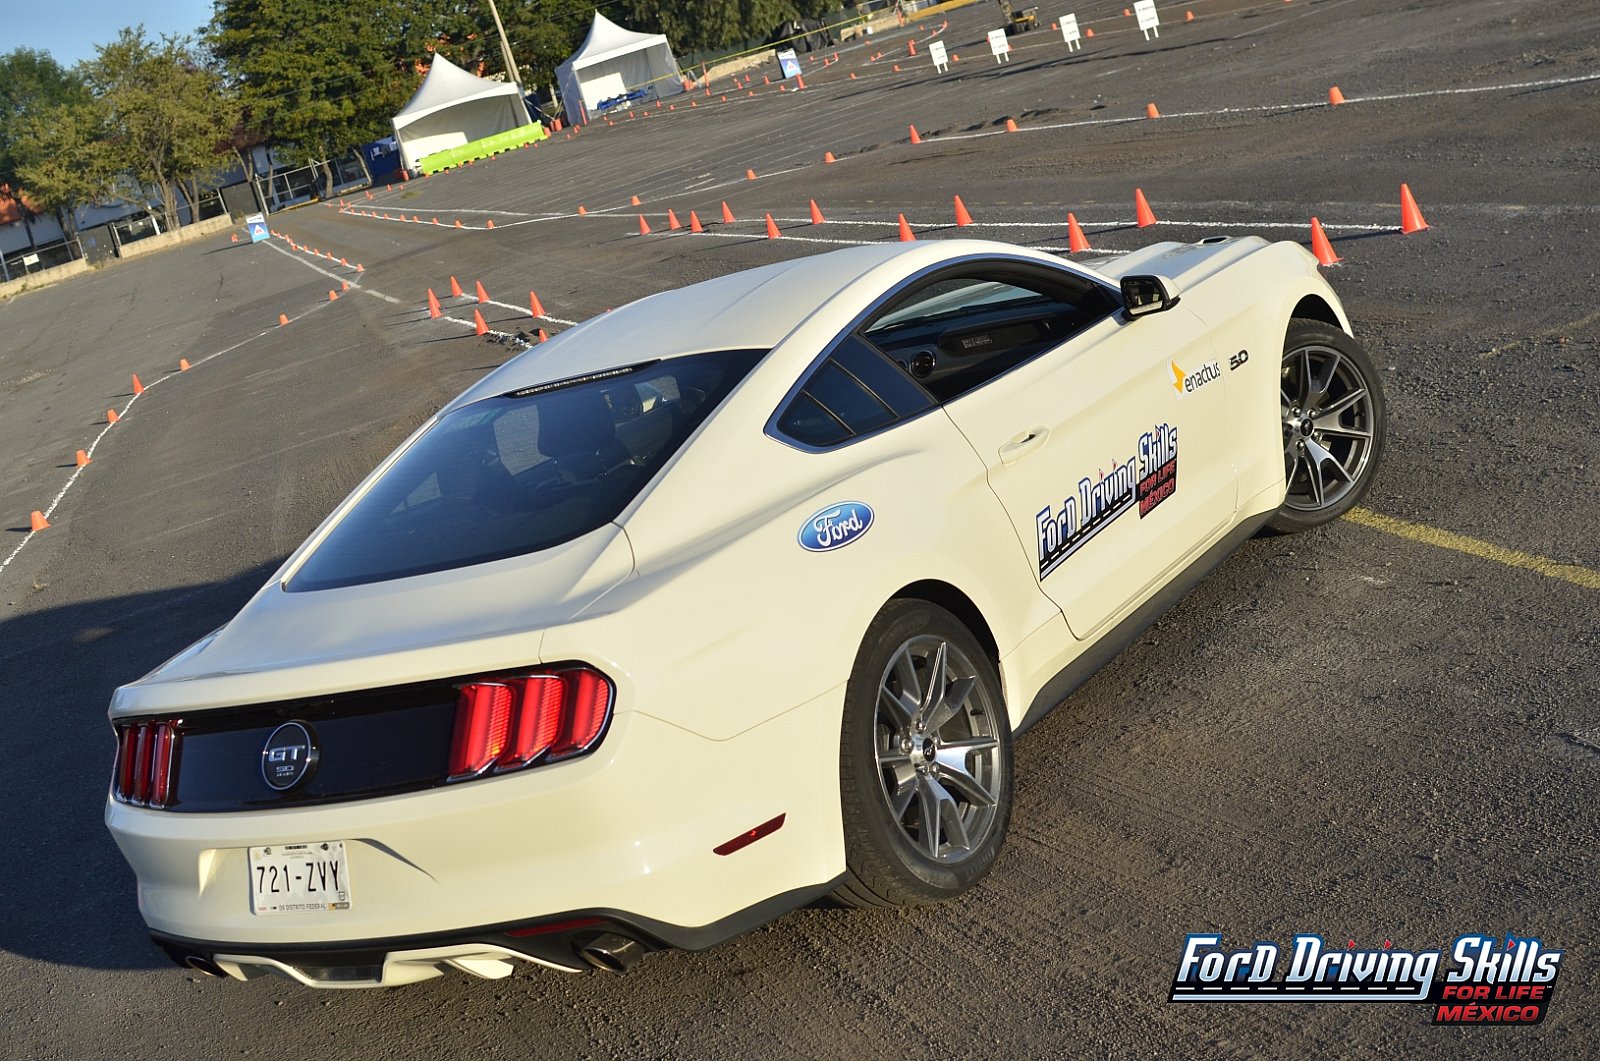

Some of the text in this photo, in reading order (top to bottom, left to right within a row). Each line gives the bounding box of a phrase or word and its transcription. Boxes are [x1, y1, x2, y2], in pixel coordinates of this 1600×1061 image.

[1184, 362, 1221, 393] enactus
[1078, 456, 1136, 528] Driving
[1138, 423, 1178, 480] Skills
[1139, 460, 1176, 497] FOR LIFE
[1139, 477, 1176, 514] MÉXICO
[813, 508, 864, 547] Ford
[268, 744, 306, 762] GT
[256, 860, 339, 894] 721-ZVY
